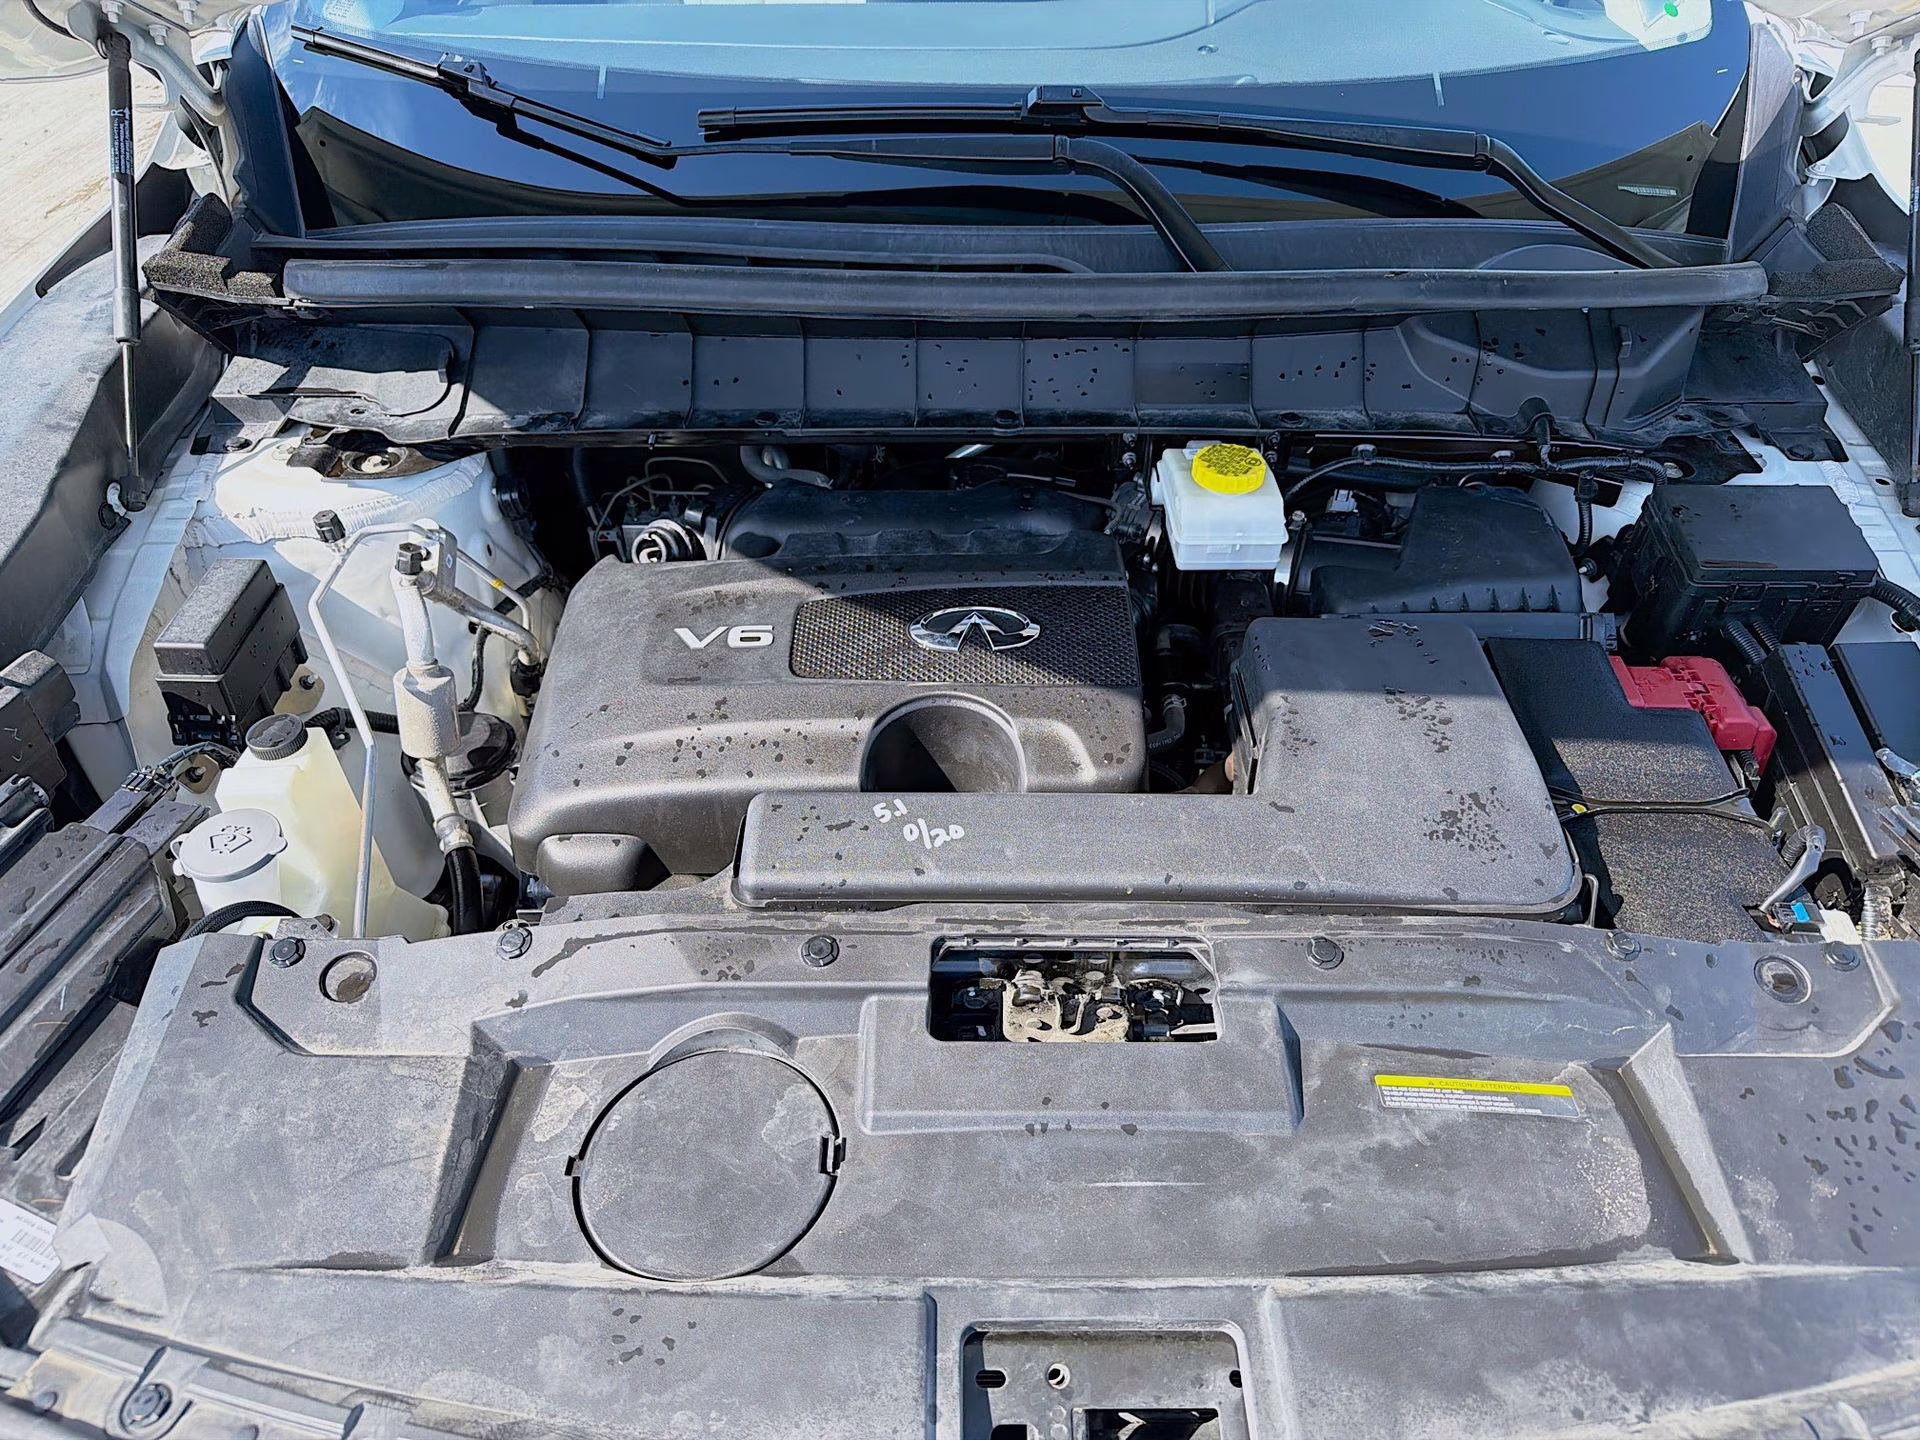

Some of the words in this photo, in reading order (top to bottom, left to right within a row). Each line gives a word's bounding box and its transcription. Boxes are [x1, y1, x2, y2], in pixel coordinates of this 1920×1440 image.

[673, 625, 774, 649] V6
[873, 799, 908, 823] 5.1
[903, 818, 965, 849] 0/20
[1481, 1083, 1521, 1091] ATTENTION
